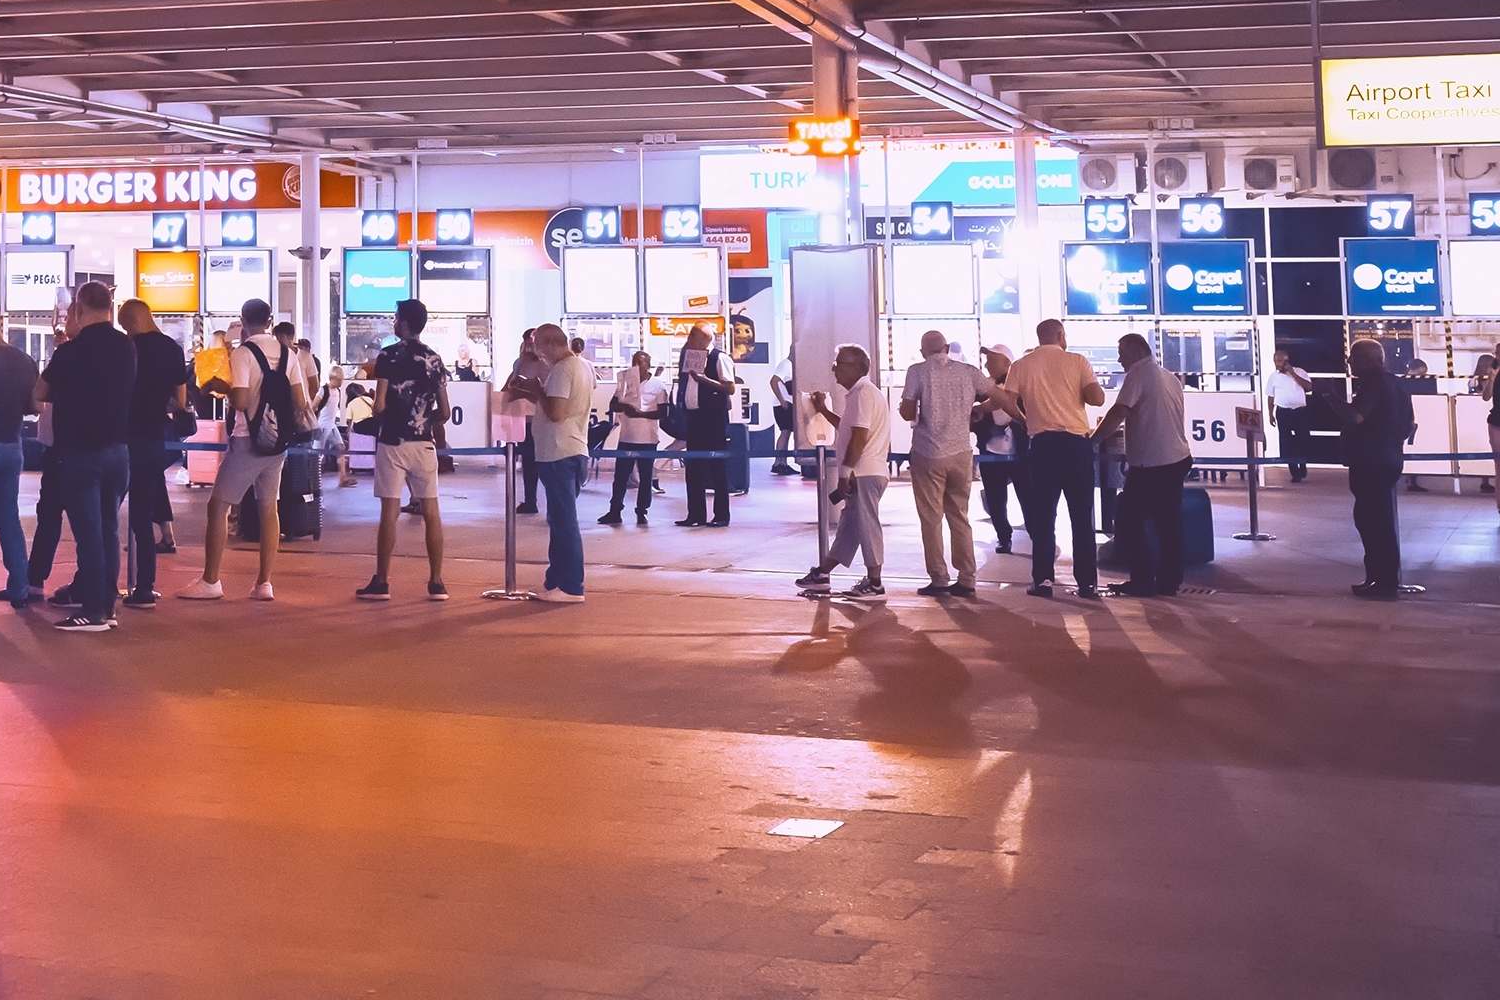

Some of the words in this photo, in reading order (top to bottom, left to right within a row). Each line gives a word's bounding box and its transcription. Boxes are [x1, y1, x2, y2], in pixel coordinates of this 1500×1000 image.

[1346, 83, 1431, 105] Airport
[1440, 80, 1492, 99] Taxi
[1347, 108, 1381, 121] Taxi
[19, 172, 158, 205] BURGER
[166, 168, 257, 203] KING
[437, 212, 472, 241] 50
[586, 210, 618, 239] 51
[663, 208, 700, 238] 52
[912, 206, 951, 236] 54
[1086, 204, 1127, 233] 55
[1181, 203, 1223, 233] 56
[1368, 200, 1412, 231] 57
[152, 216, 186, 243] 47
[551, 227, 583, 248] se
[705, 236, 724, 244] 444
[33, 273, 61, 285] PEGAS
[1194, 269, 1243, 286] Coral
[1384, 268, 1435, 285] Coral
[451, 406, 463, 426] 0
[1191, 419, 1226, 442] 56
